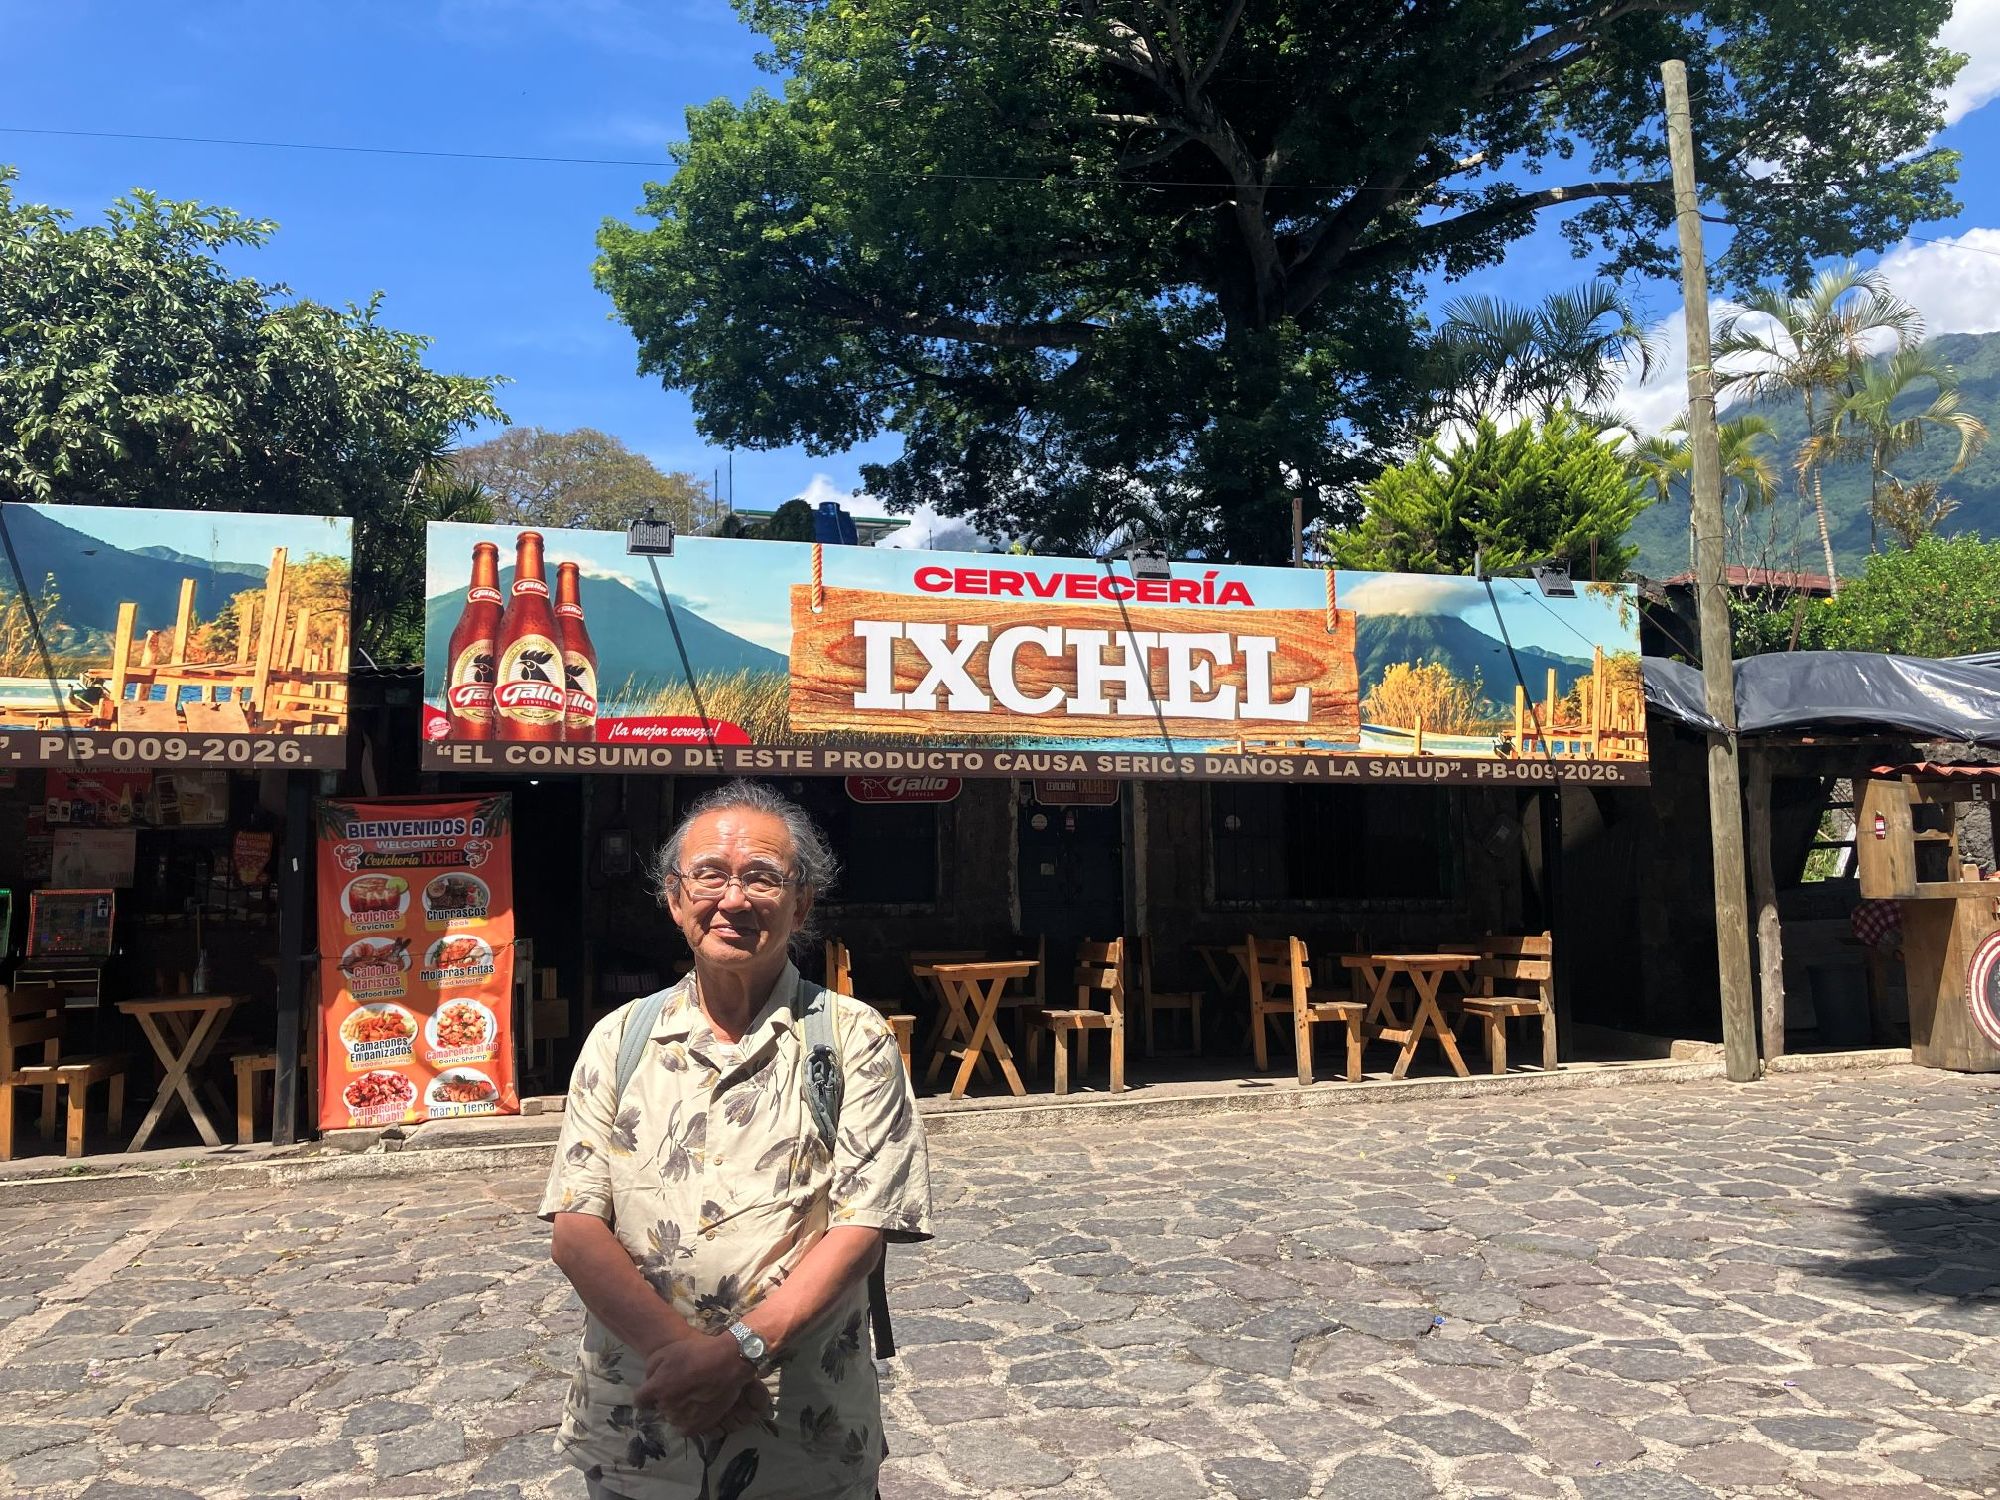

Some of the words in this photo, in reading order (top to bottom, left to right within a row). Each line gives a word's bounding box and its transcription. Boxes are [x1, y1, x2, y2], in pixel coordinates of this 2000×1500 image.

[517, 581, 547, 593] Gallo
[913, 566, 1256, 607] CERVECERÍA
[472, 589, 501, 601] Gallo
[853, 620, 1312, 722] IXCHEL
[501, 683, 564, 706] Gallo
[632, 723, 670, 740] mejor
[671, 722, 720, 739] cerveza!
[39, 737, 313, 763] PB-009-2026.
[505, 746, 672, 767] CONSUMO
[684, 748, 724, 768] DE
[736, 749, 813, 769] ESTE
[824, 751, 983, 770] PRODUCTO
[994, 753, 1085, 772] CAUSA
[1205, 756, 1294, 775] DAÑOS
[1302, 759, 1320, 776] A
[1328, 760, 1360, 777] LA
[1477, 763, 1625, 780] PB-009-2026.
[887, 776, 949, 797] Gallo
[347, 819, 466, 839] BIENVENIDOS
[470, 819, 484, 836] A
[376, 839, 438, 849] WELCOME
[440, 838, 456, 847] TO
[421, 851, 464, 865] IXCHEL
[350, 909, 400, 924] Ceviches
[426, 907, 486, 921] Churrascos
[355, 922, 395, 932] Ceviches
[353, 965, 383, 979] Caldo
[384, 963, 398, 976] de
[351, 976, 401, 991] Mariscos
[353, 1037, 408, 1053] Camarones
[426, 1045, 473, 1061] Camarones
[350, 1044, 412, 1063] Empanizados
[461, 1053, 487, 1064] Shrimp
[352, 1101, 408, 1118] Camarones
[430, 1105, 450, 1118] Mar
[453, 1105, 460, 1117] y
[463, 1102, 495, 1115] Tierra
